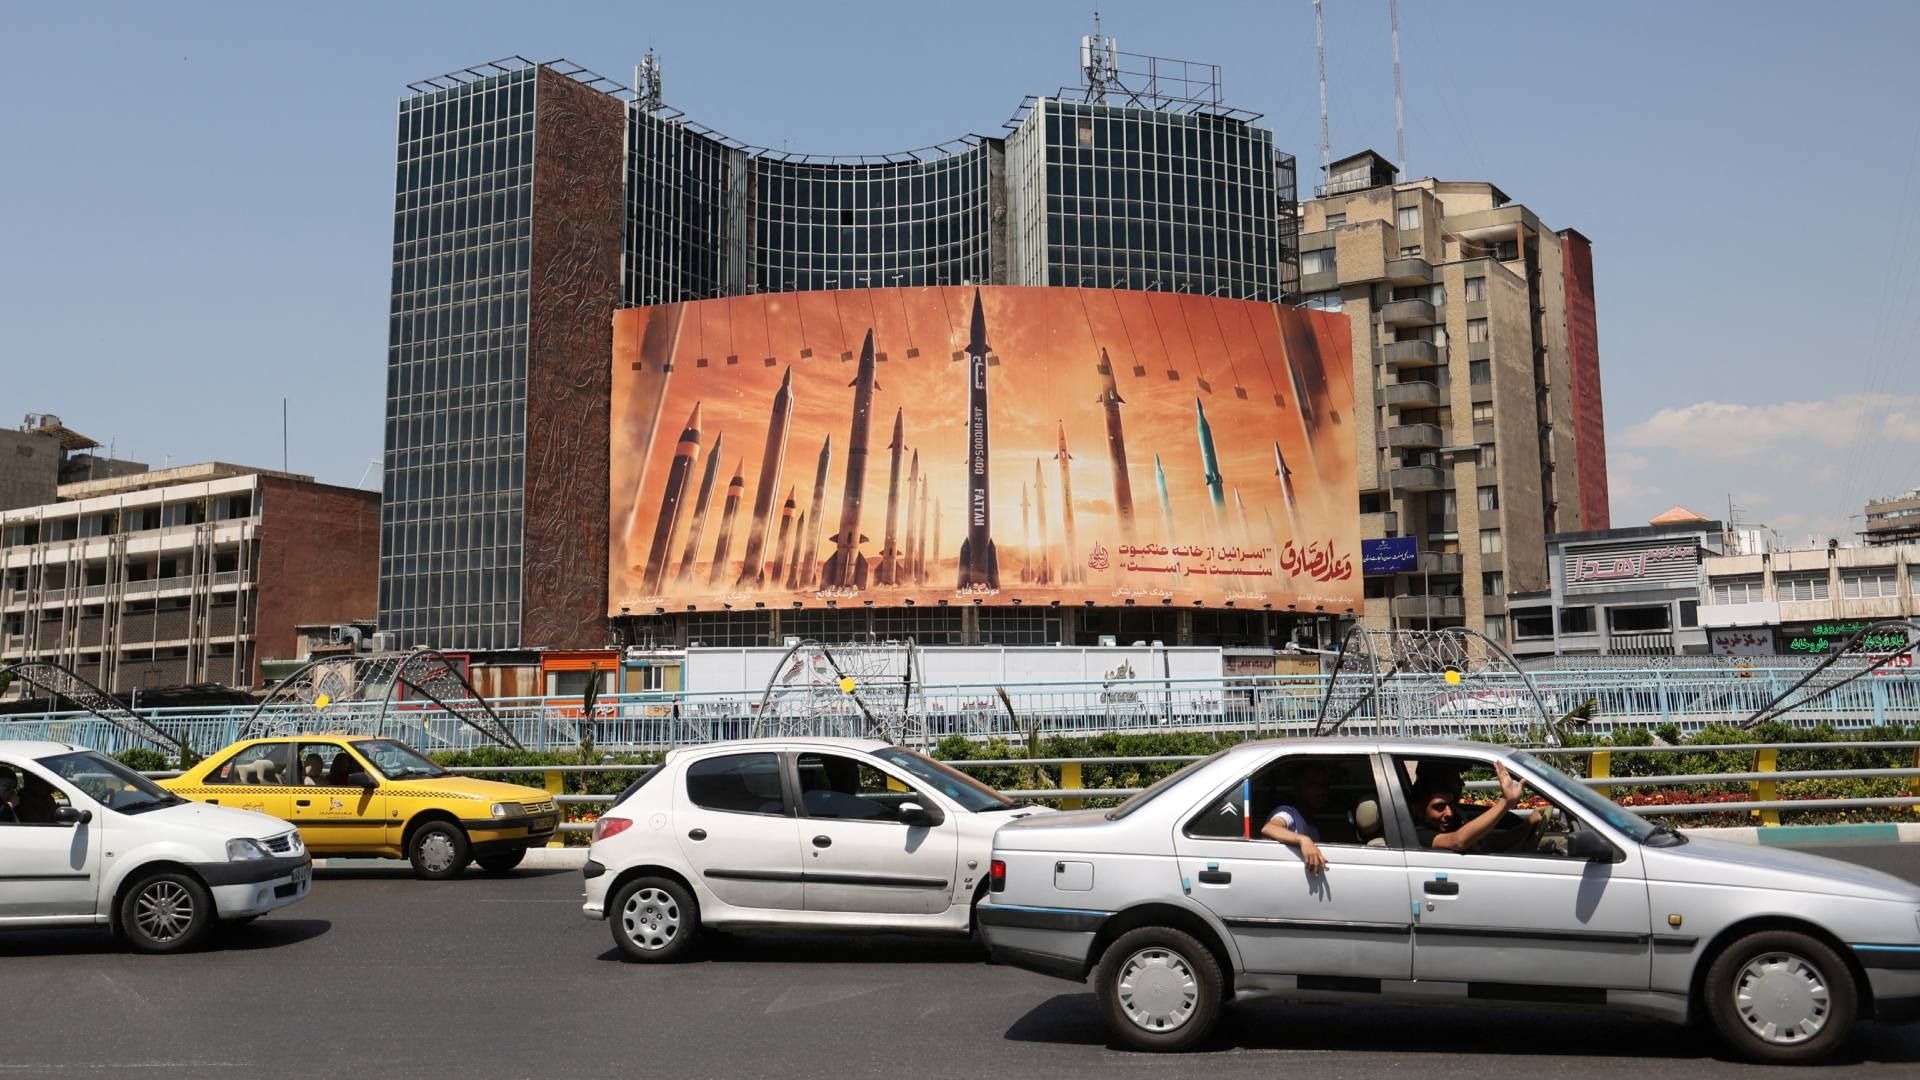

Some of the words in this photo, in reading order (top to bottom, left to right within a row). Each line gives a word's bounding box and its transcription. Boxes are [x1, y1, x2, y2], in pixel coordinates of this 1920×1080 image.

[974, 488, 985, 526] FATTAH
[1118, 544, 1169, 559] عنکبوت
[1172, 545, 1204, 557] خانه
[1206, 546, 1215, 562] از
[1184, 564, 1207, 577] تر
[1791, 637, 1829, 653] داروخانه
